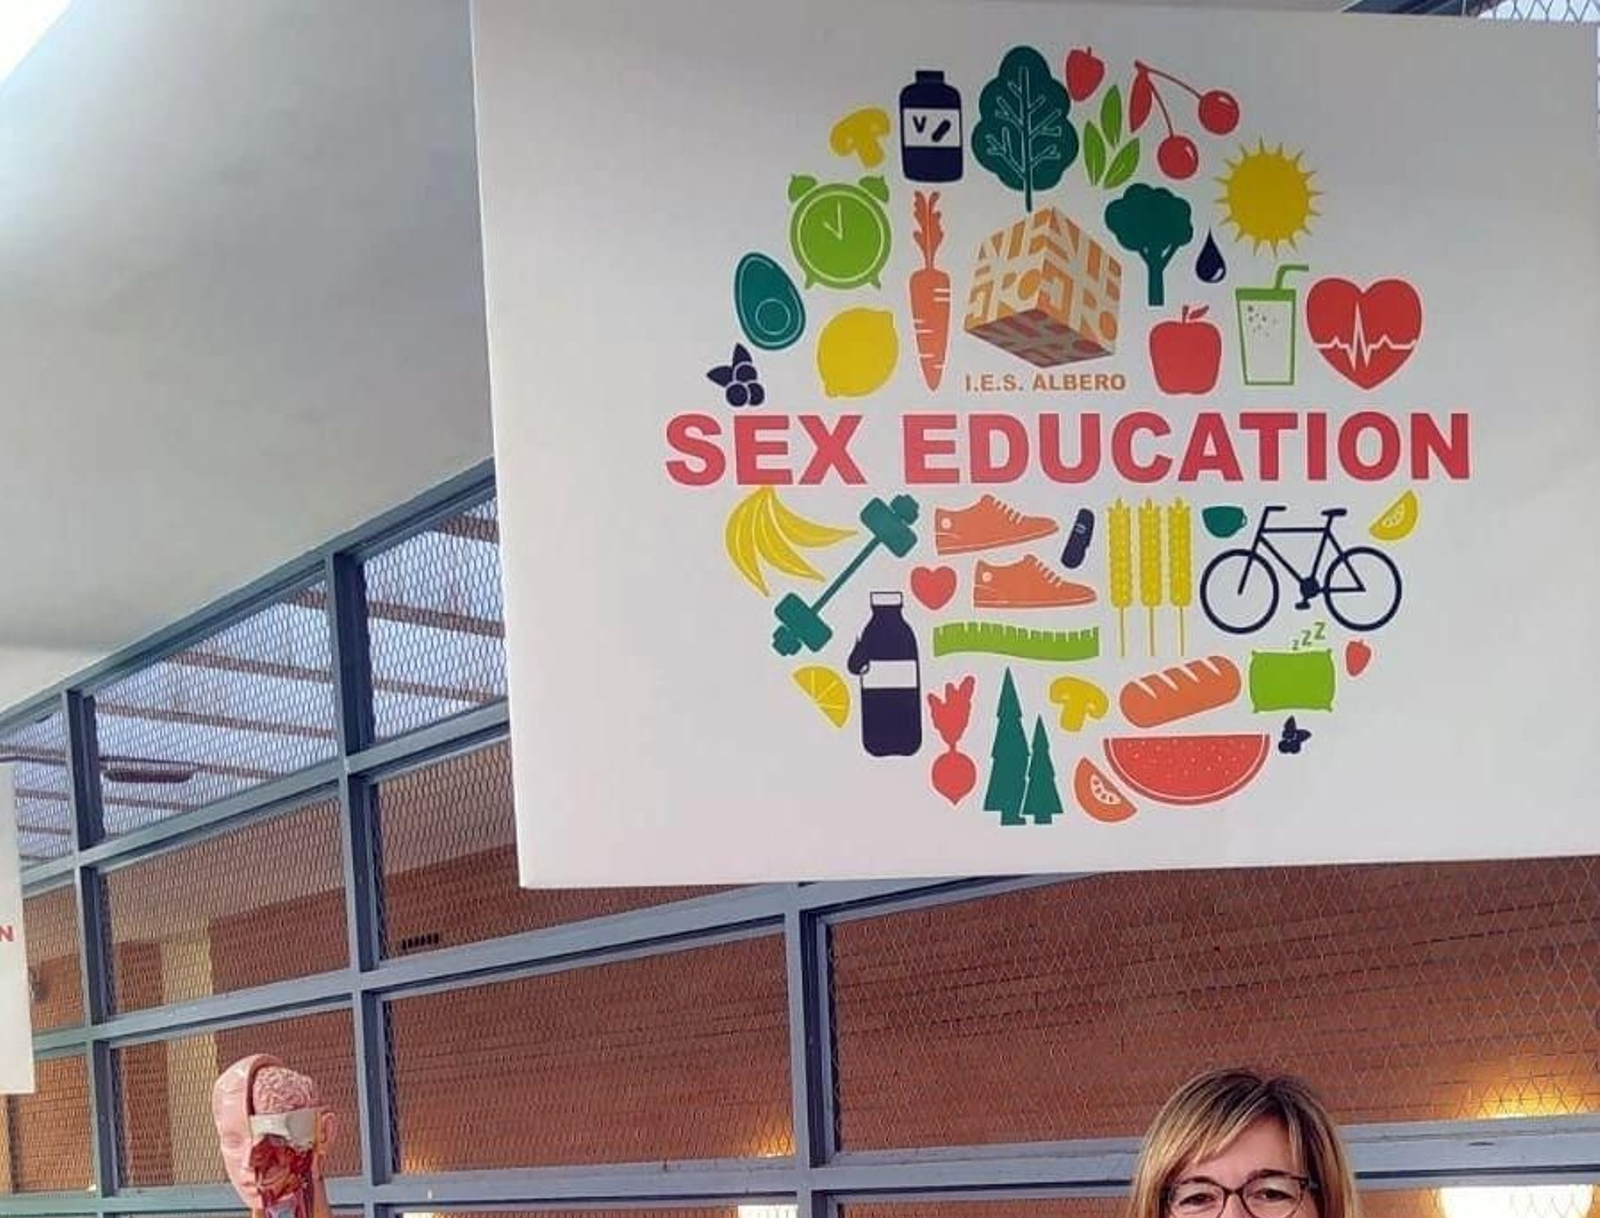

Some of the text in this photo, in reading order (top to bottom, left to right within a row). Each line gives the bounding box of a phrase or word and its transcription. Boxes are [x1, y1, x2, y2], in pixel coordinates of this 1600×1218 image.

[965, 373, 1126, 392] I.E.S. ALBERO
[665, 411, 1471, 486] SEX EDUCATION
